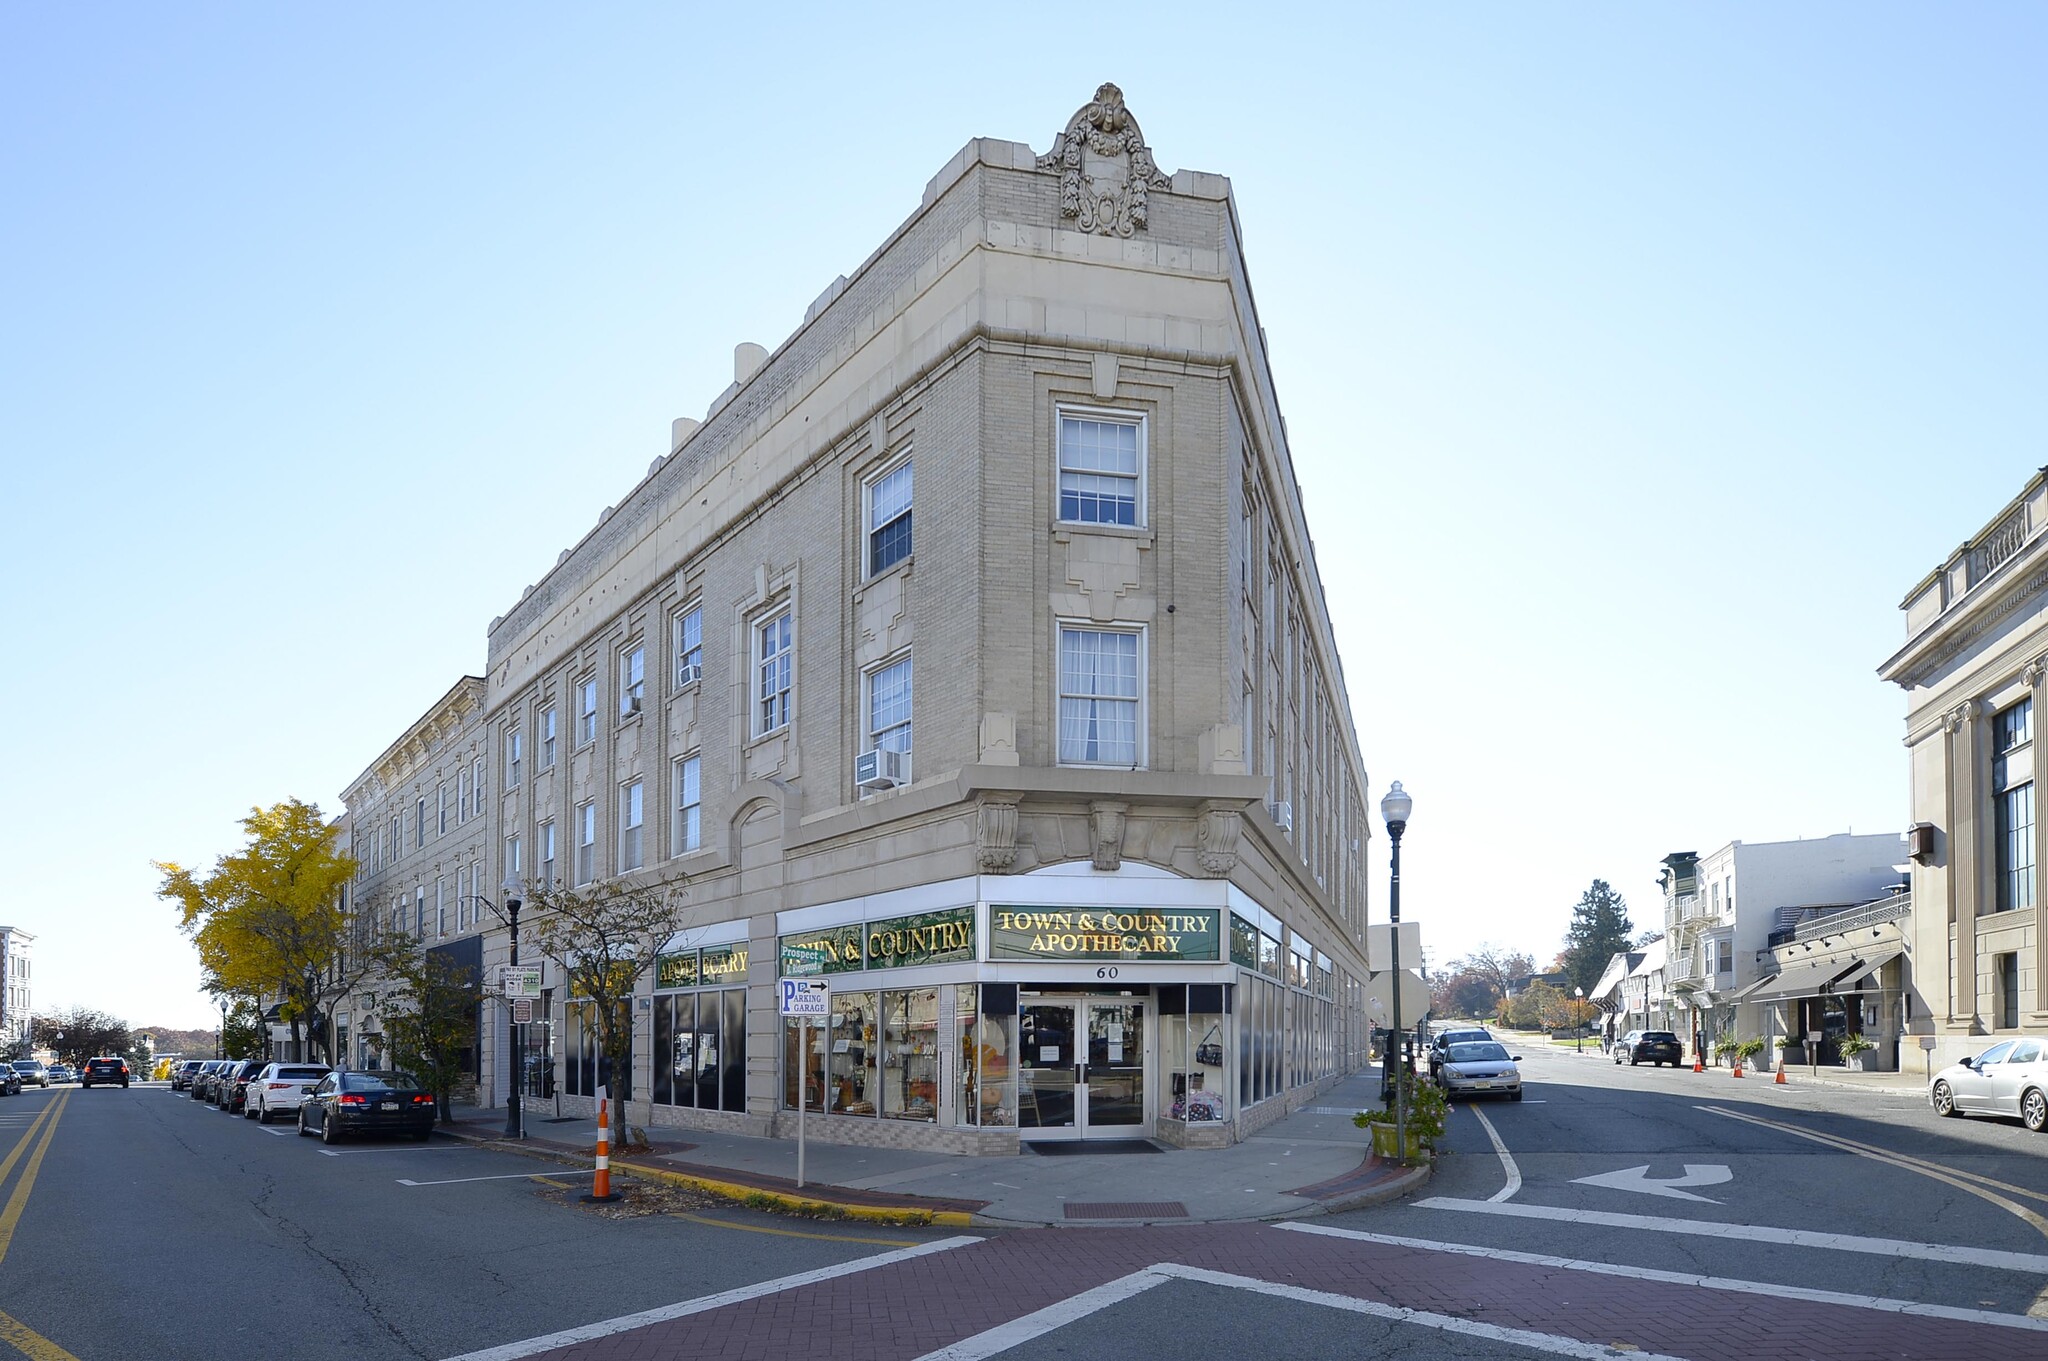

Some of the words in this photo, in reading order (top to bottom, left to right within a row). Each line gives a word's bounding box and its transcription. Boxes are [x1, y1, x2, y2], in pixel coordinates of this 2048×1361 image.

[998, 912, 1072, 931] TOWN
[1078, 913, 1096, 931] &
[1102, 914, 1210, 933] COUNTRY
[845, 938, 862, 962] &
[868, 921, 971, 959] COUNTRY
[1030, 934, 1181, 953] APOTHECARY
[782, 946, 818, 960] Prospect
[660, 951, 748, 980] APOTHECARY
[1096, 967, 1119, 979] 60
[783, 981, 821, 1012] PARKING
[794, 1004, 825, 1012] GARAGE
